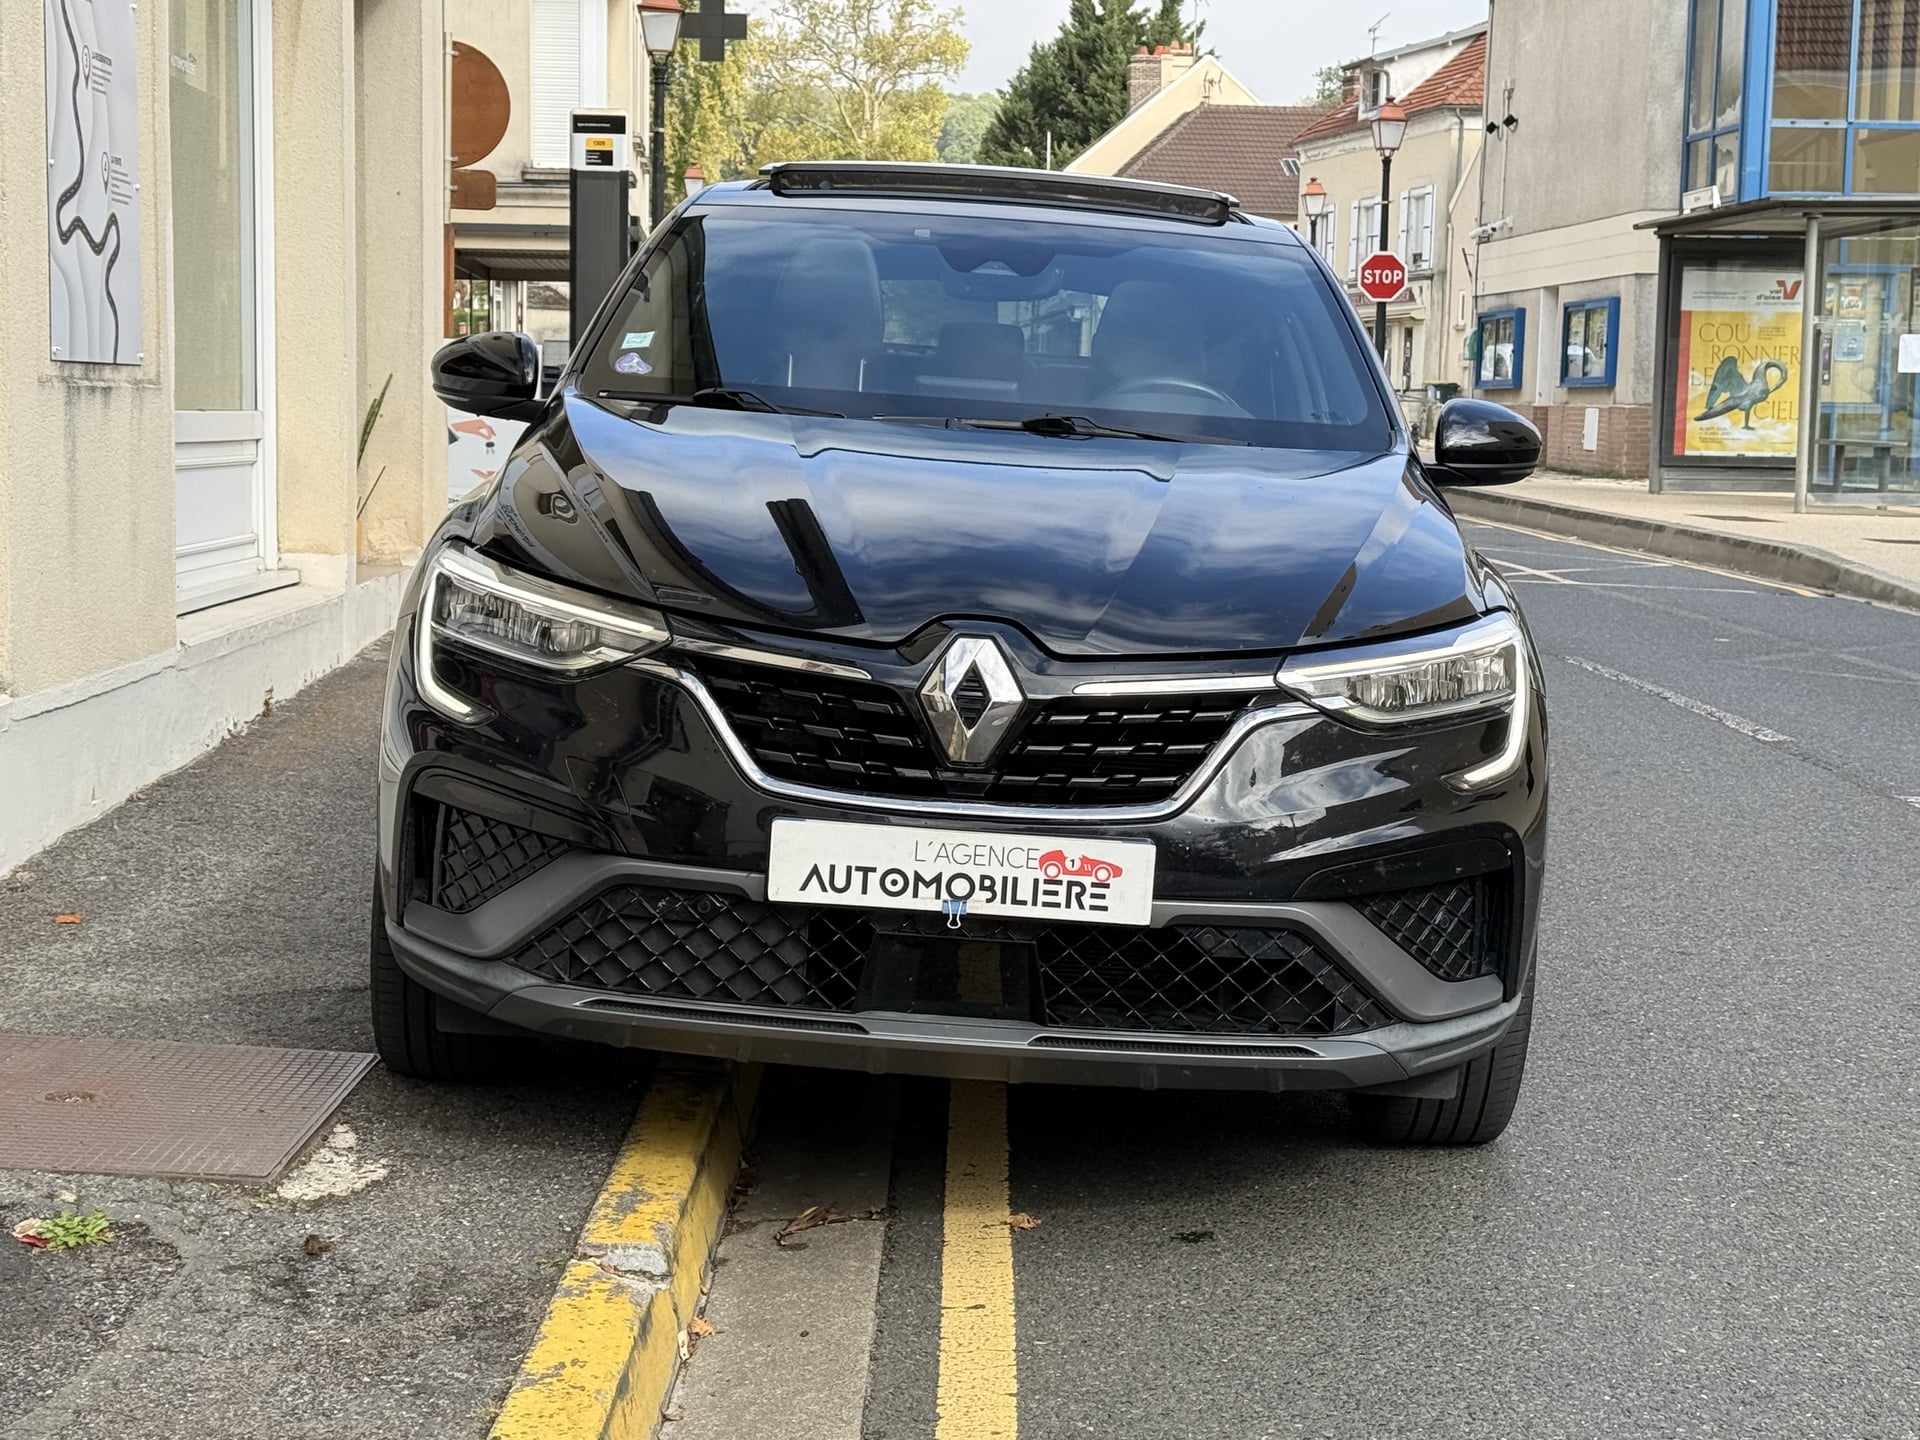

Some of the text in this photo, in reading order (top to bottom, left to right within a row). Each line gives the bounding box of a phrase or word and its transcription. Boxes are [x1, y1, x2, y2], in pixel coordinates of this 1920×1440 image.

[1363, 269, 1402, 284] STOP
[1699, 323, 1751, 343] COU
[1711, 345, 1800, 364] RONNER
[1691, 367, 1714, 386] LE
[1753, 401, 1799, 420] CIEL
[914, 839, 1040, 870] L'AGENCE
